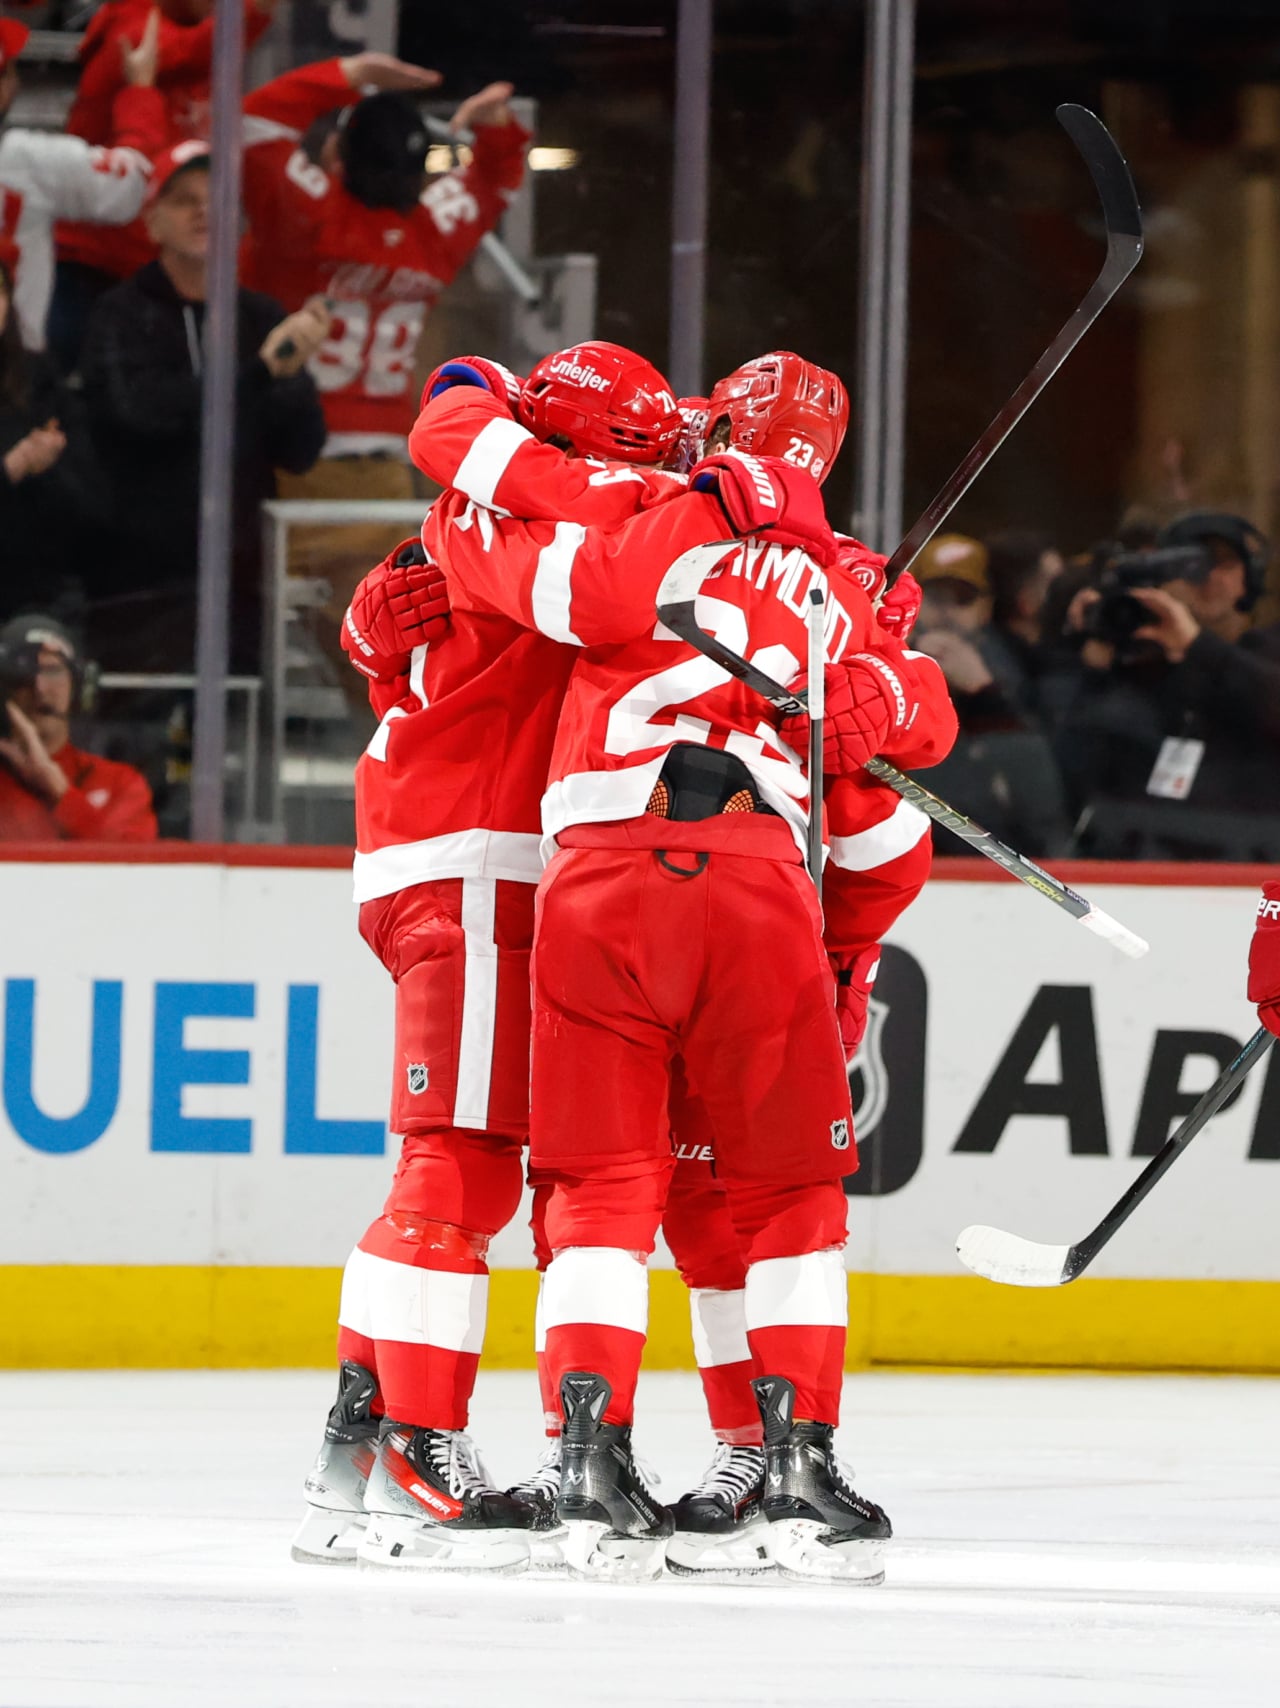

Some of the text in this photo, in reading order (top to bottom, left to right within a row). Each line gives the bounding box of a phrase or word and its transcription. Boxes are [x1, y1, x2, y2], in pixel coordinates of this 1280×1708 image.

[552, 357, 611, 393] meijer
[783, 436, 815, 469] 23
[2, 978, 387, 1155] UEL
[408, 1482, 451, 1515] BAUER
[629, 1490, 658, 1523] BAUER
[834, 1488, 871, 1519] BAUER
